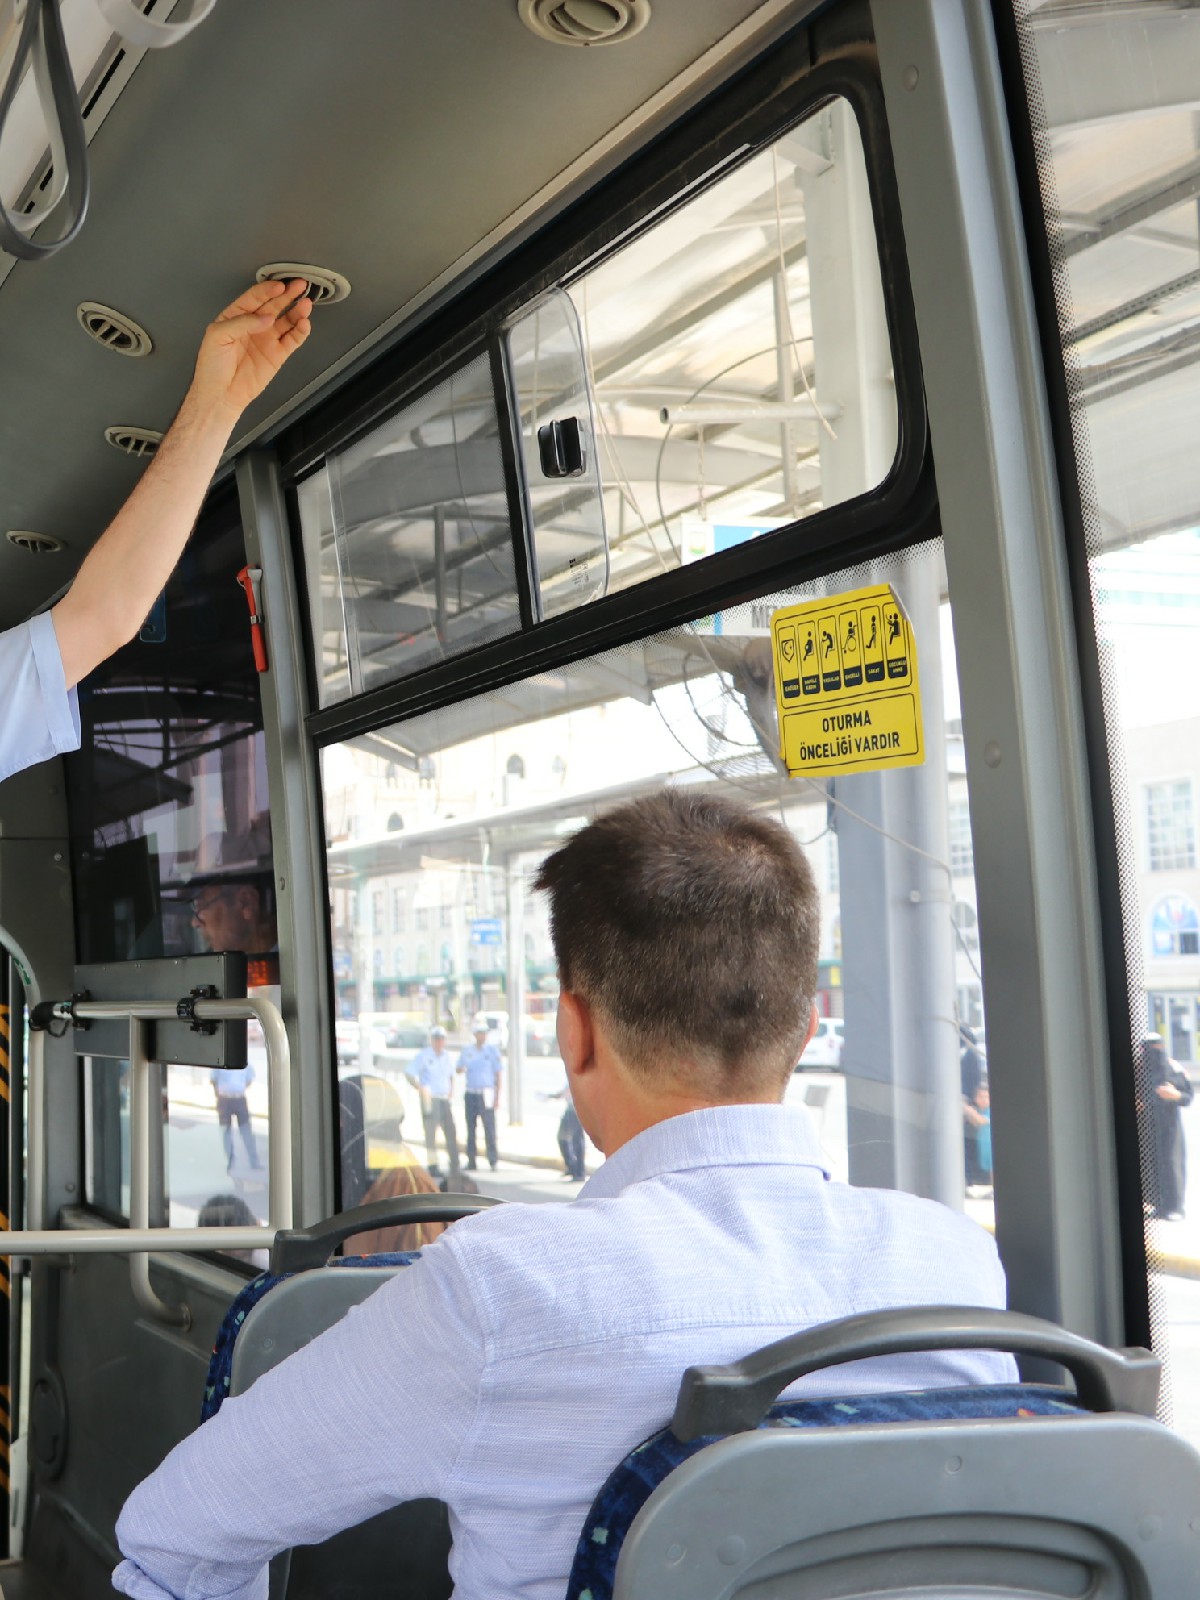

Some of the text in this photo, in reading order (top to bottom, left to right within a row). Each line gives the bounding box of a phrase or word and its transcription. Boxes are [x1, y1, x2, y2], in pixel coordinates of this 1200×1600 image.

[822, 710, 872, 732] OTURMA
[800, 732, 900, 760] ÖNCELİĞİ VARDIR
